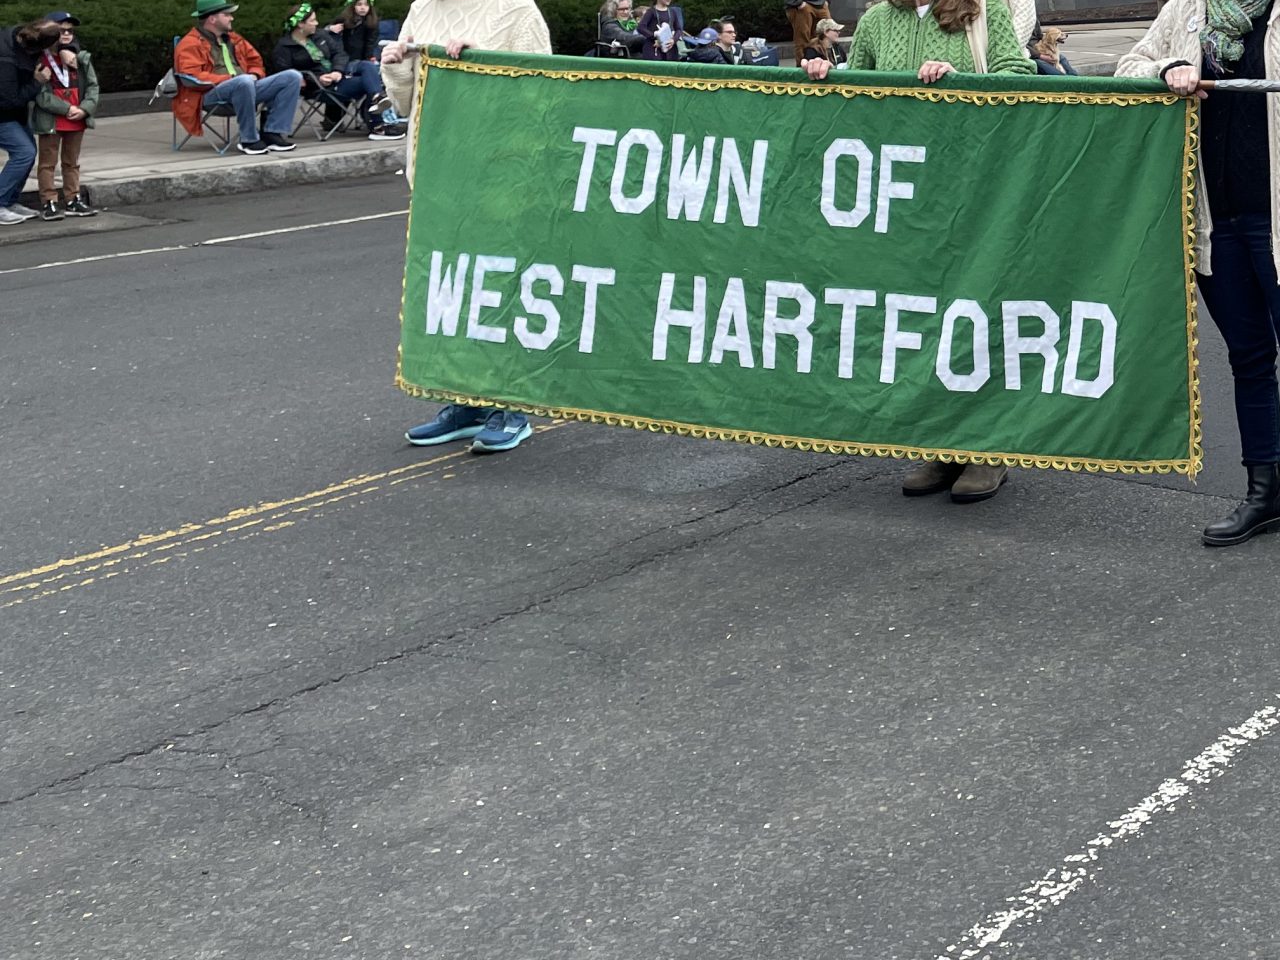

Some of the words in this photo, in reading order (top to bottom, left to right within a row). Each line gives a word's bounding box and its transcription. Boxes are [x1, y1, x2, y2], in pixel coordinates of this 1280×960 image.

[572, 126, 769, 227] TOWN
[820, 137, 926, 233] OF
[425, 250, 615, 353] WEST
[651, 271, 1118, 400] HARTFORD
